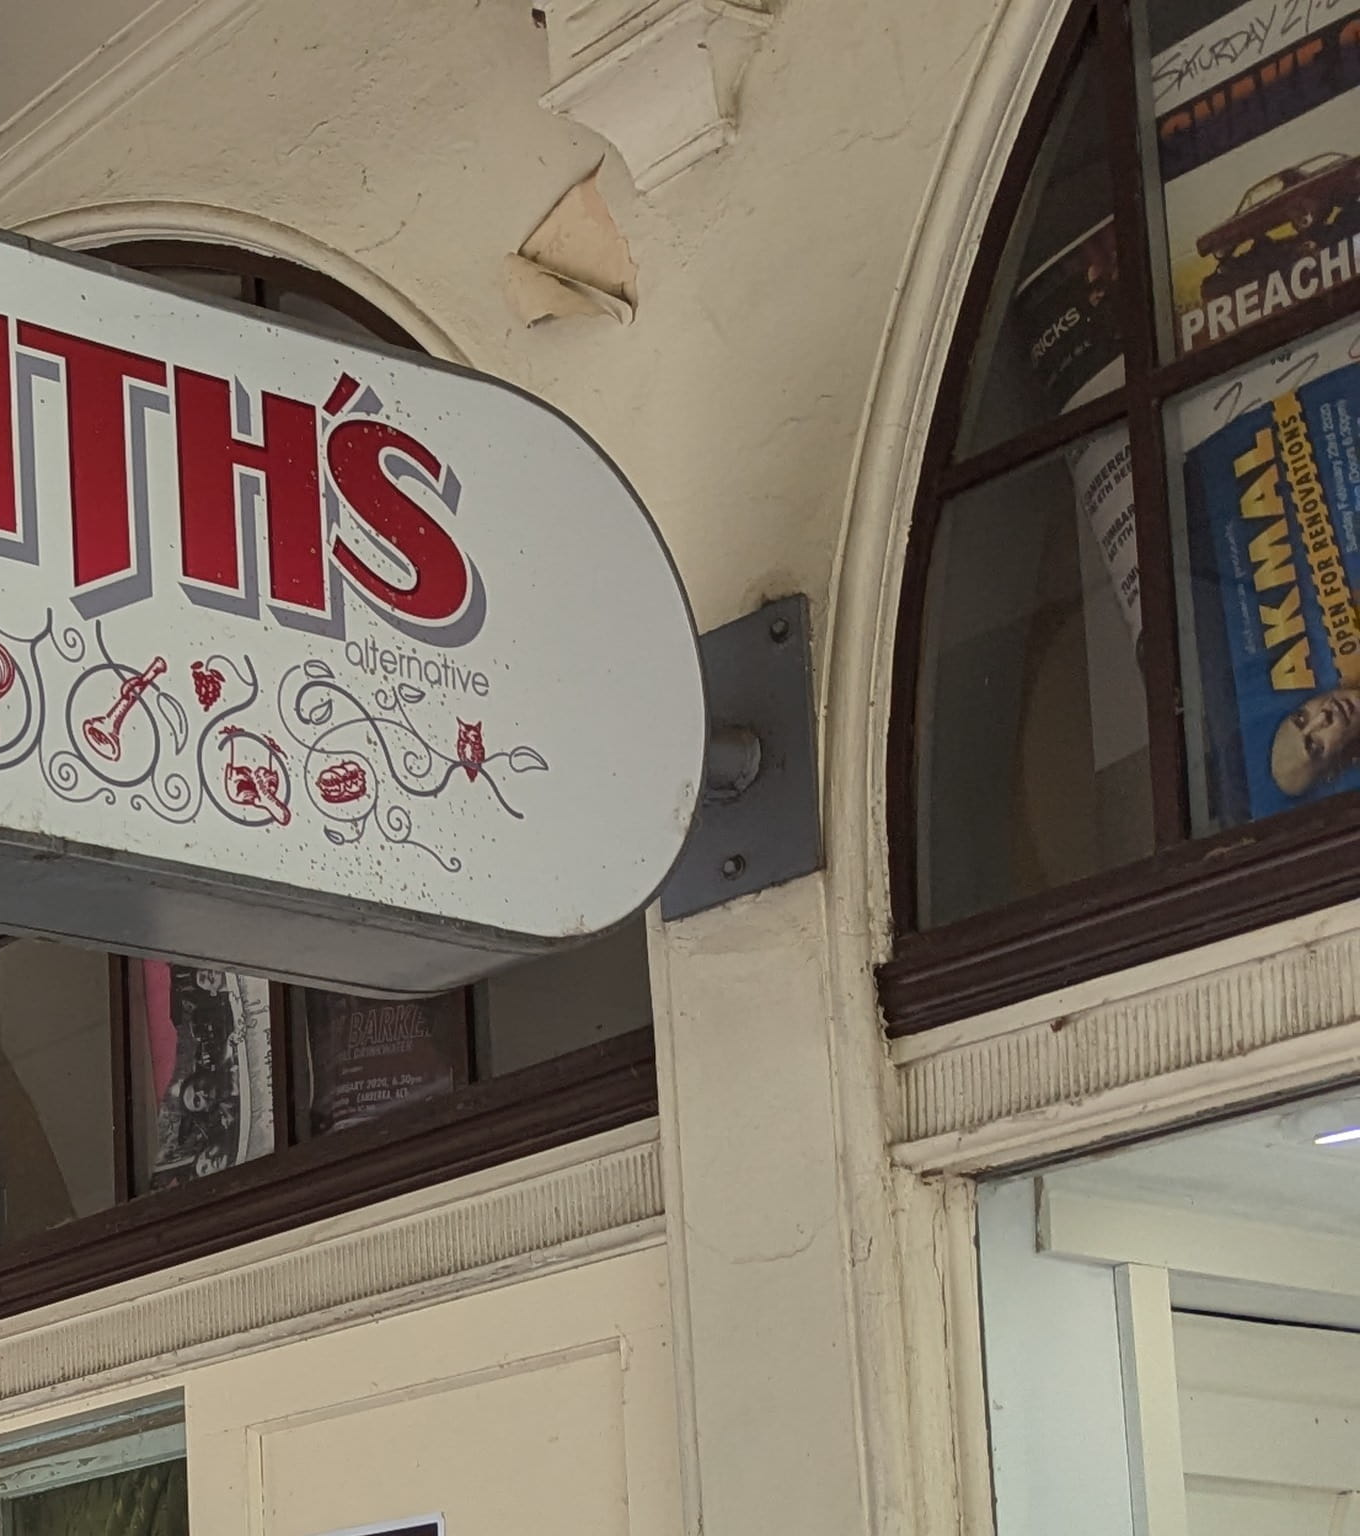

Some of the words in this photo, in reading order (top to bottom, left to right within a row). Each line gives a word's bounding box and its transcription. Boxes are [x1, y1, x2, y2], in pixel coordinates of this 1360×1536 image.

[1150, 3, 1278, 100] SATURDAY
[1281, 415, 1330, 553] RENOVATIONS
[1234, 427, 1316, 690] AKMAL
[1317, 555, 1339, 599] FOR
[343, 636, 492, 701] alternative
[1330, 608, 1357, 656] OPEN
